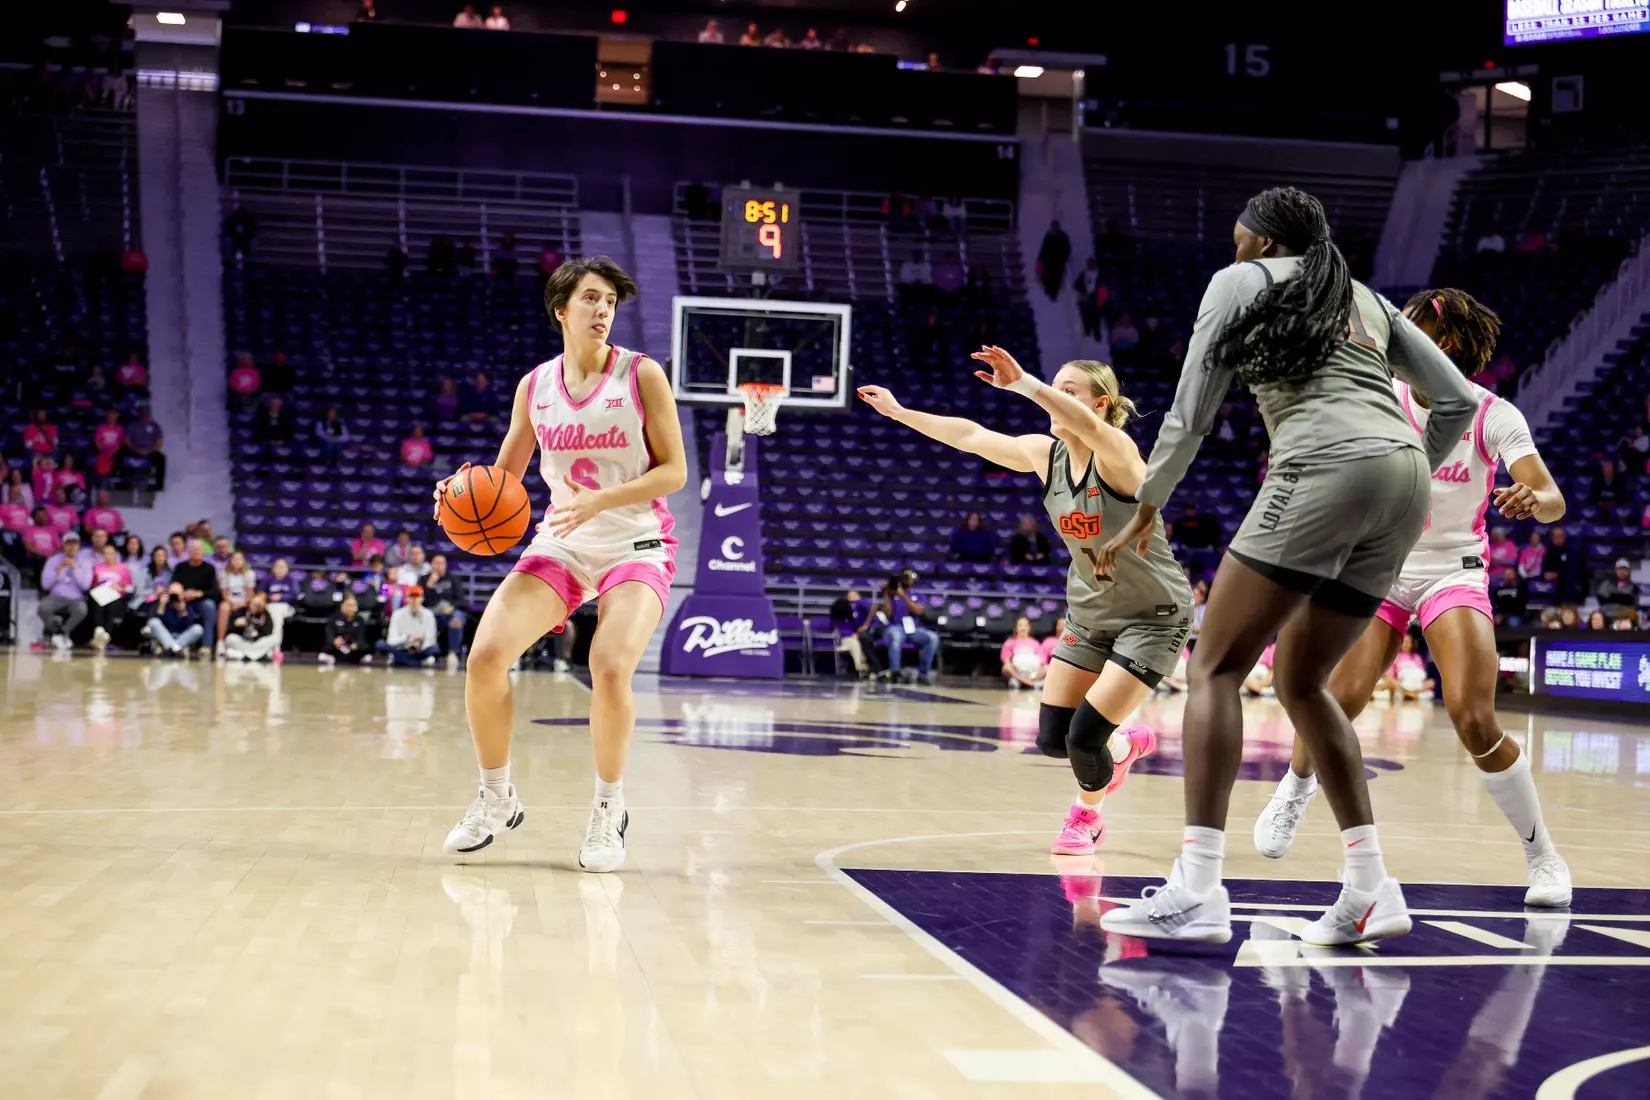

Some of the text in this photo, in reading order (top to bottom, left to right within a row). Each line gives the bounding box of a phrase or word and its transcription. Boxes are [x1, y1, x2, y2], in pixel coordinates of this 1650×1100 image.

[1224, 43, 1270, 77] 15
[745, 199, 789, 223] 8:51
[759, 223, 781, 259] 9
[537, 422, 629, 451] Wildcats
[1059, 510, 1102, 541] OSU
[1259, 487, 1295, 532] LOYAL
[708, 558, 756, 573] Channel
[679, 615, 779, 658] Dillons
